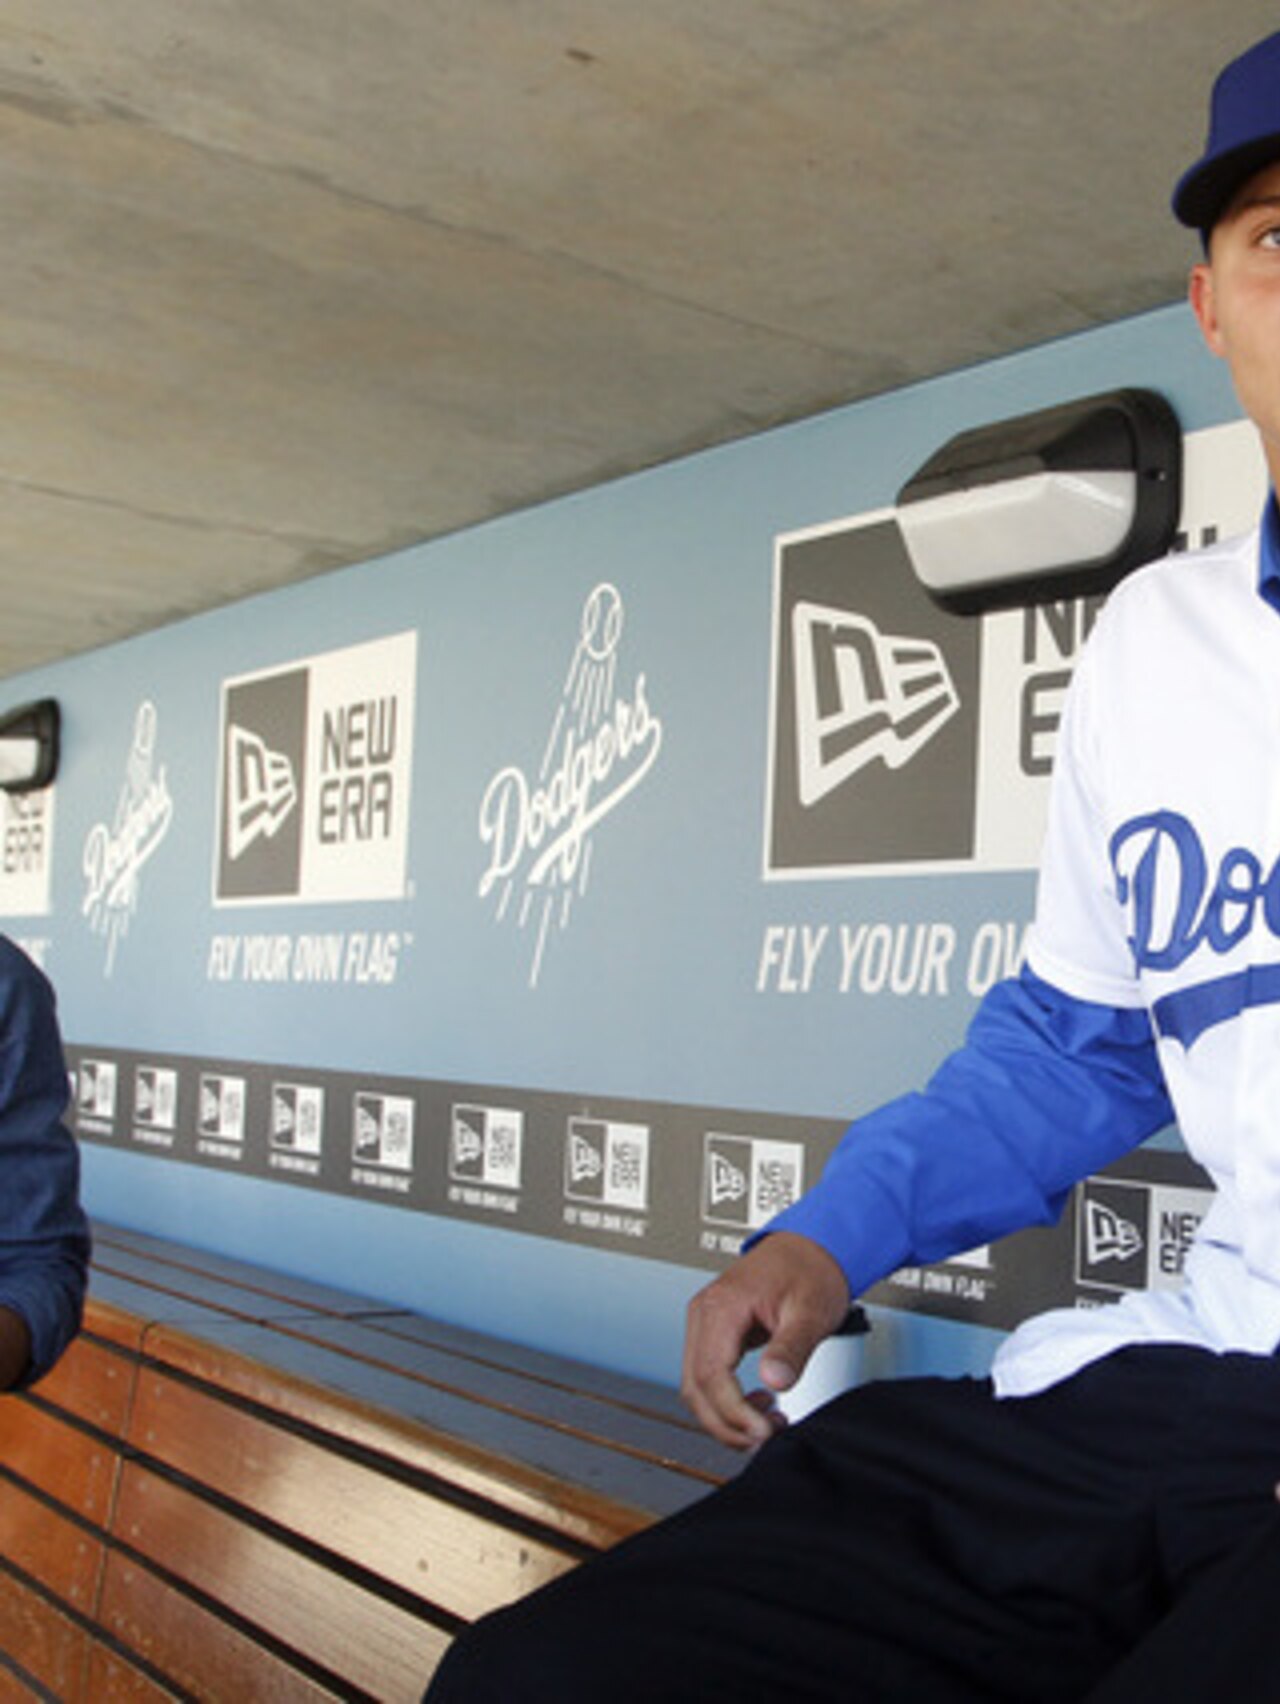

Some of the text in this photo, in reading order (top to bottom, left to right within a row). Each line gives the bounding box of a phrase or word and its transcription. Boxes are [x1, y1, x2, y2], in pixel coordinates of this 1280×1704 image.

[321, 695, 398, 774] NEW
[317, 771, 393, 845] ERA
[480, 672, 662, 898] Dodgers
[206, 932, 401, 984] FLY YOUR OWN FLAG
[755, 924, 829, 993] FLY
[838, 923, 956, 996] YOUR
